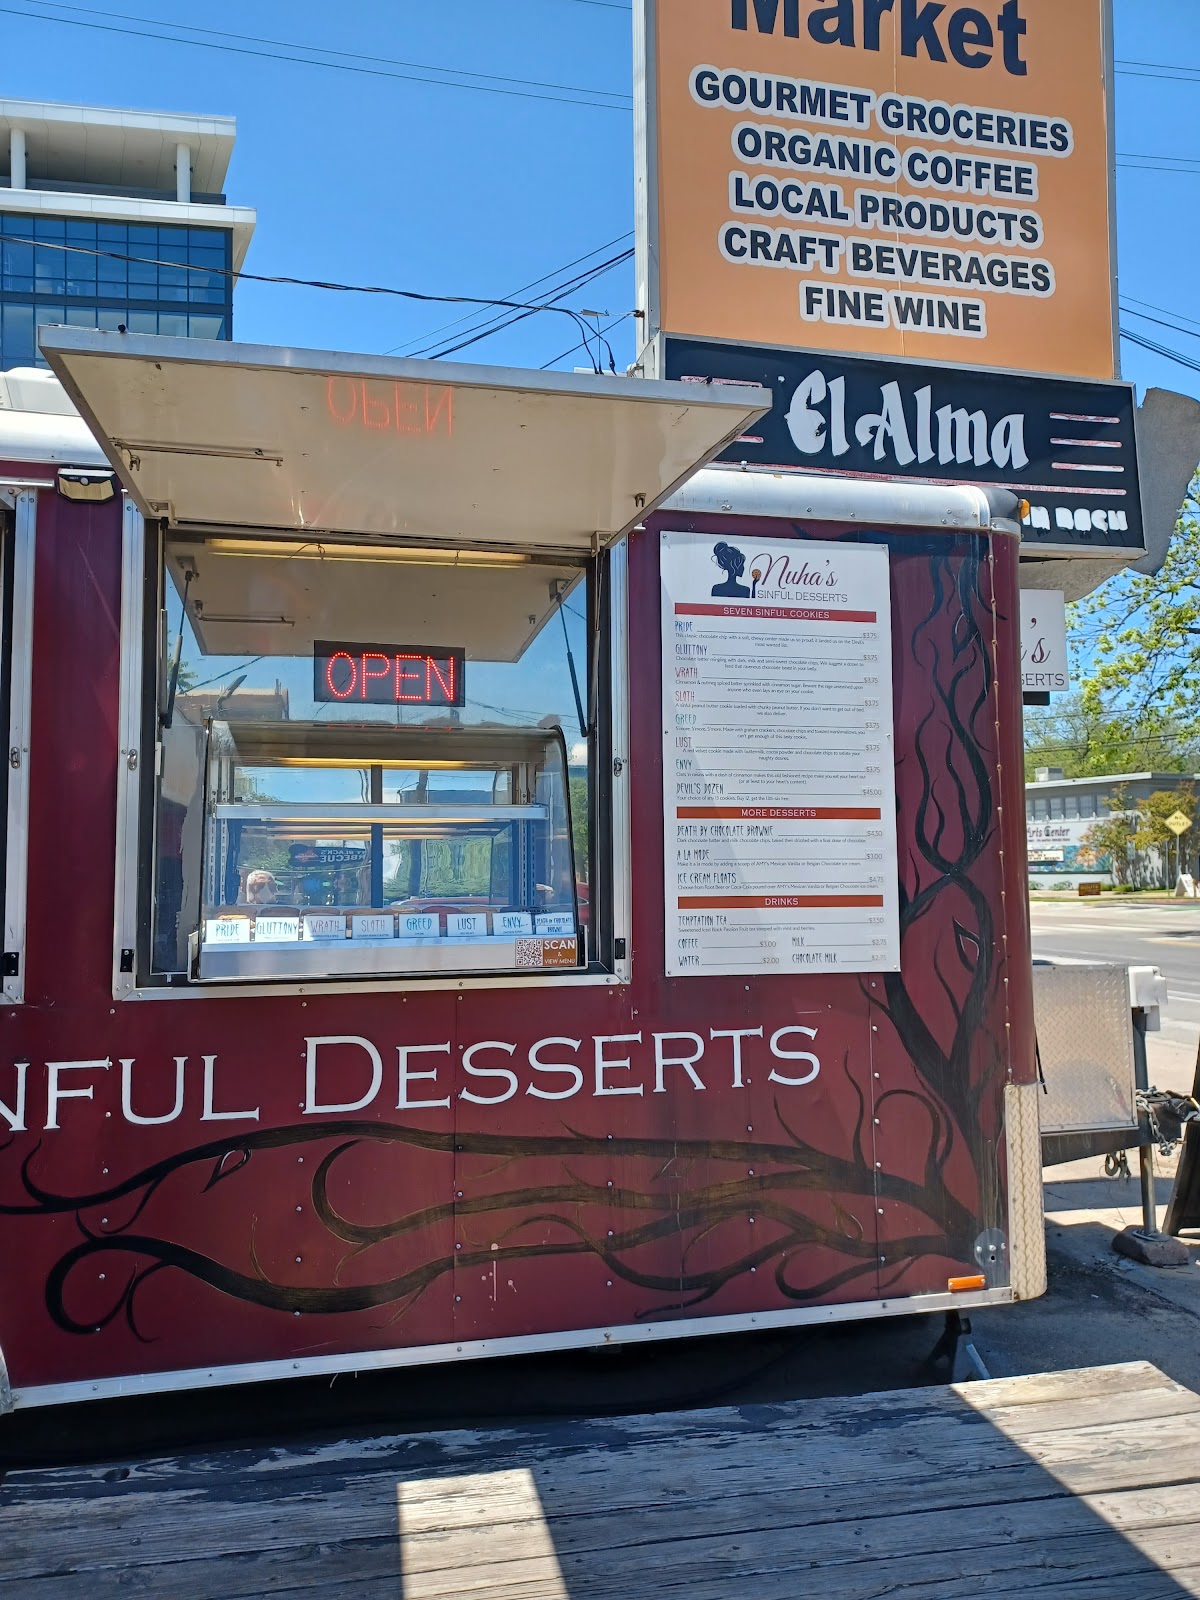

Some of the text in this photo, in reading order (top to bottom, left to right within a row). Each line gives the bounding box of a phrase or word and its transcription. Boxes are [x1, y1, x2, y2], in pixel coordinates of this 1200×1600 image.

[696, 71, 1068, 151] GOURMET GROCERIES
[738, 128, 1033, 195] ORGANIC COFFEE
[735, 178, 1038, 244] LOCAL PRODUCTS
[724, 227, 1050, 291] CRAFT BEVERAGES
[806, 286, 981, 331] FINE WINE
[784, 370, 1029, 469] El Alma
[750, 553, 838, 589] Nuha's
[758, 590, 848, 602] SINFUL DESSERTS
[724, 607, 829, 618] SEVEN SINFUL COOKIES
[675, 620, 693, 632] PRIDE
[676, 644, 708, 656] GLUTTONY
[326, 652, 454, 700] OPEN
[675, 667, 698, 679] WRATH
[675, 691, 695, 702] SLOTH
[676, 714, 697, 725] GREED
[676, 737, 692, 748] LUST
[676, 759, 692, 770] ENVY
[704, 783, 724, 794] DOZEN
[677, 825, 774, 836] DEATH BY CHOCOLATE BROWNIE
[677, 850, 710, 861] A LA MODE
[677, 873, 736, 884] ICE CREAM FLOATS
[765, 898, 798, 906] DRINKS
[311, 920, 339, 933] WRATH
[361, 919, 385, 932] SLOTH
[406, 918, 432, 930] GREED
[457, 918, 476, 930] LUST
[503, 917, 521, 928] ENVY
[678, 916, 727, 926] TEMPTATION TEA
[216, 923, 239, 936] PRIDE
[256, 921, 298, 935] GLUTTONY
[544, 940, 575, 949] SCAN
[678, 939, 698, 949] COFFEE
[792, 937, 805, 947] MILK
[678, 955, 700, 966] WATER
[792, 953, 837, 964] CHOCOLATE MILK
[302, 1026, 820, 1114] DESSERTS
